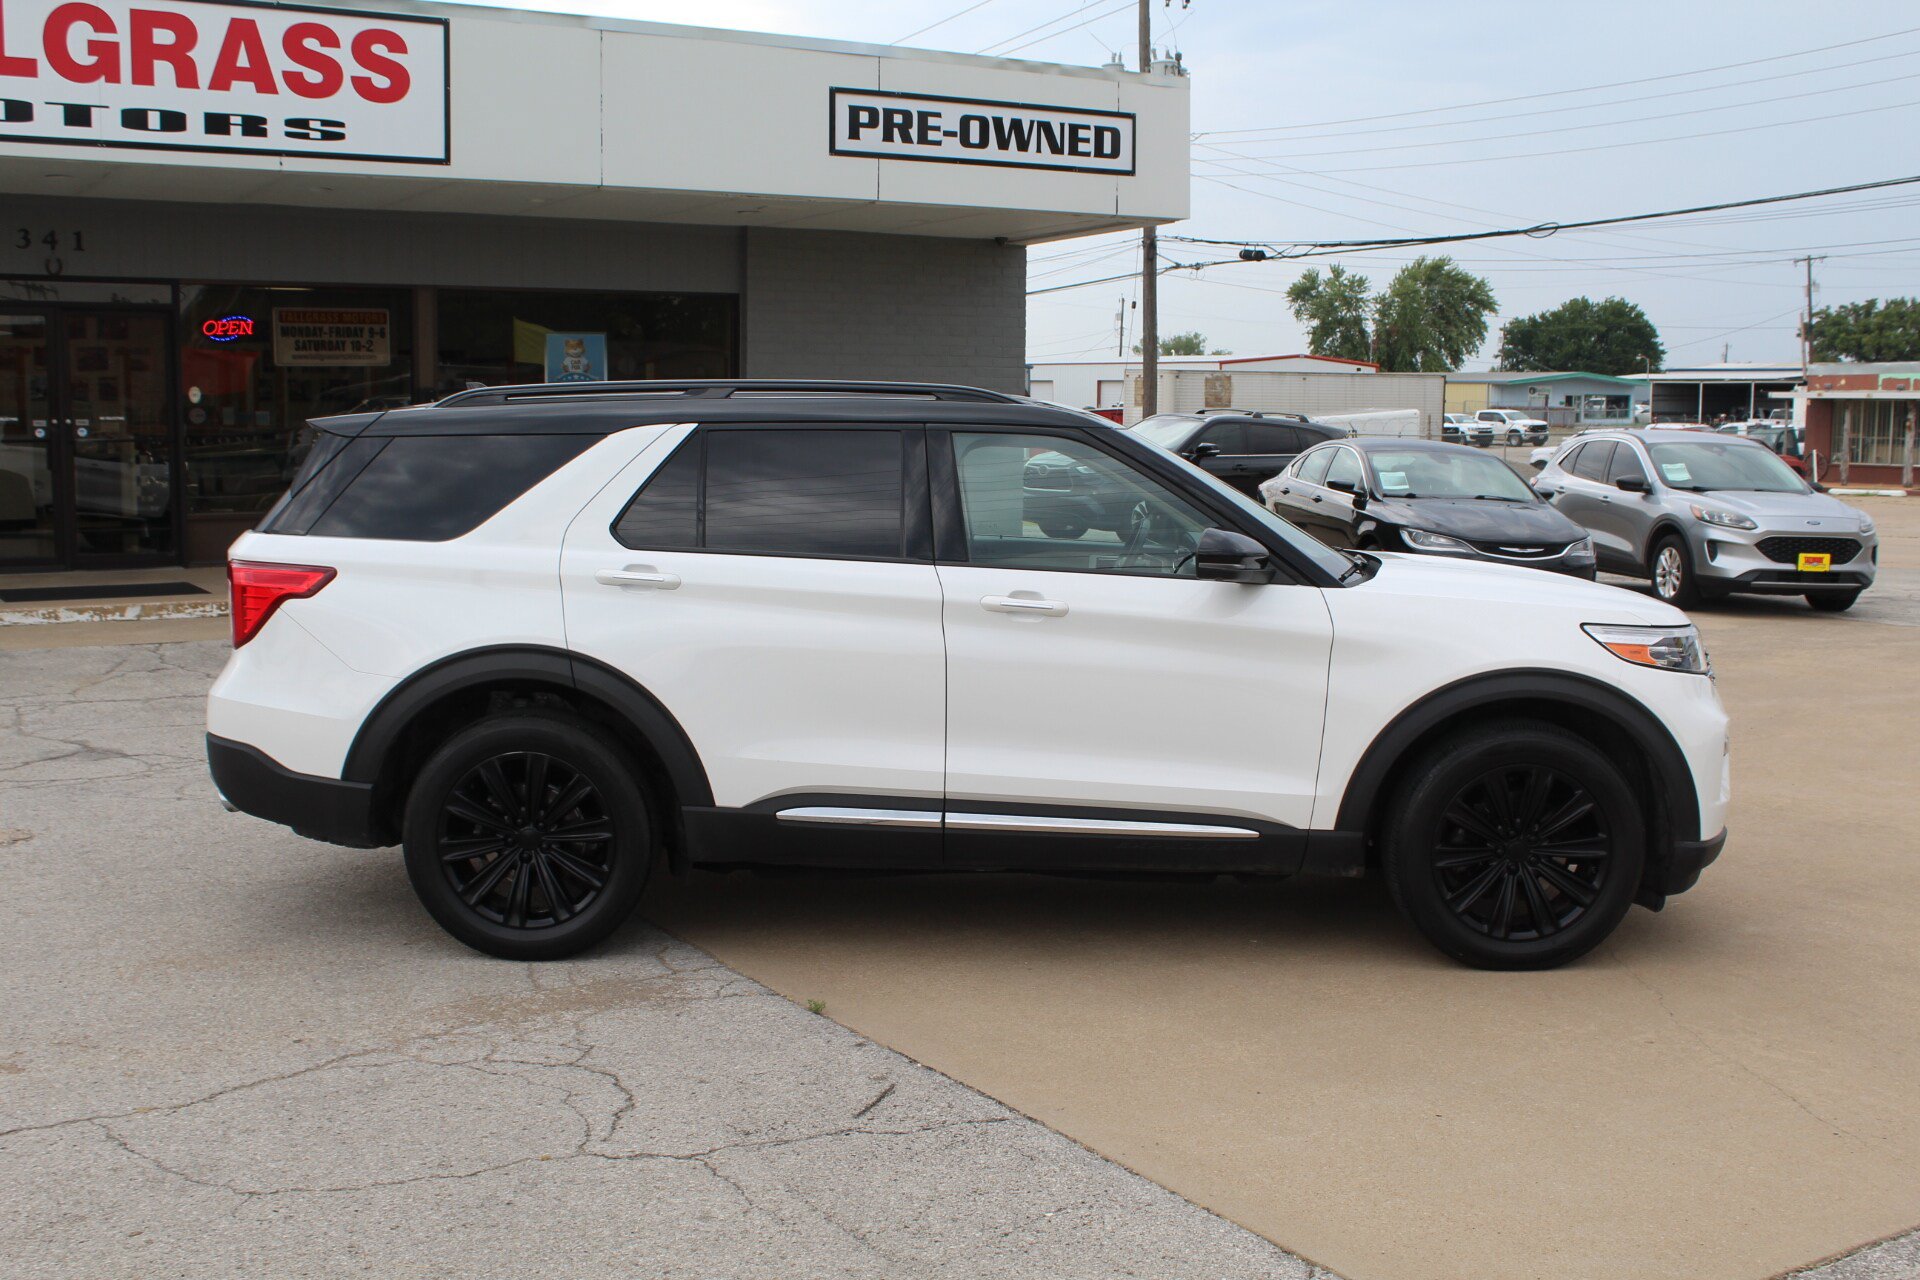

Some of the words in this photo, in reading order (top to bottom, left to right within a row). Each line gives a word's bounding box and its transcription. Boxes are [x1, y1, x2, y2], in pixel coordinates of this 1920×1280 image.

[847, 104, 1122, 160] PRE-OWNED
[15, 228, 86, 252] 341
[202, 319, 254, 336] OPEN
[280, 326, 365, 338] MONDAY-FRIDAY
[294, 339, 346, 351] SATURDAY
[350, 340, 374, 352] 10-2
